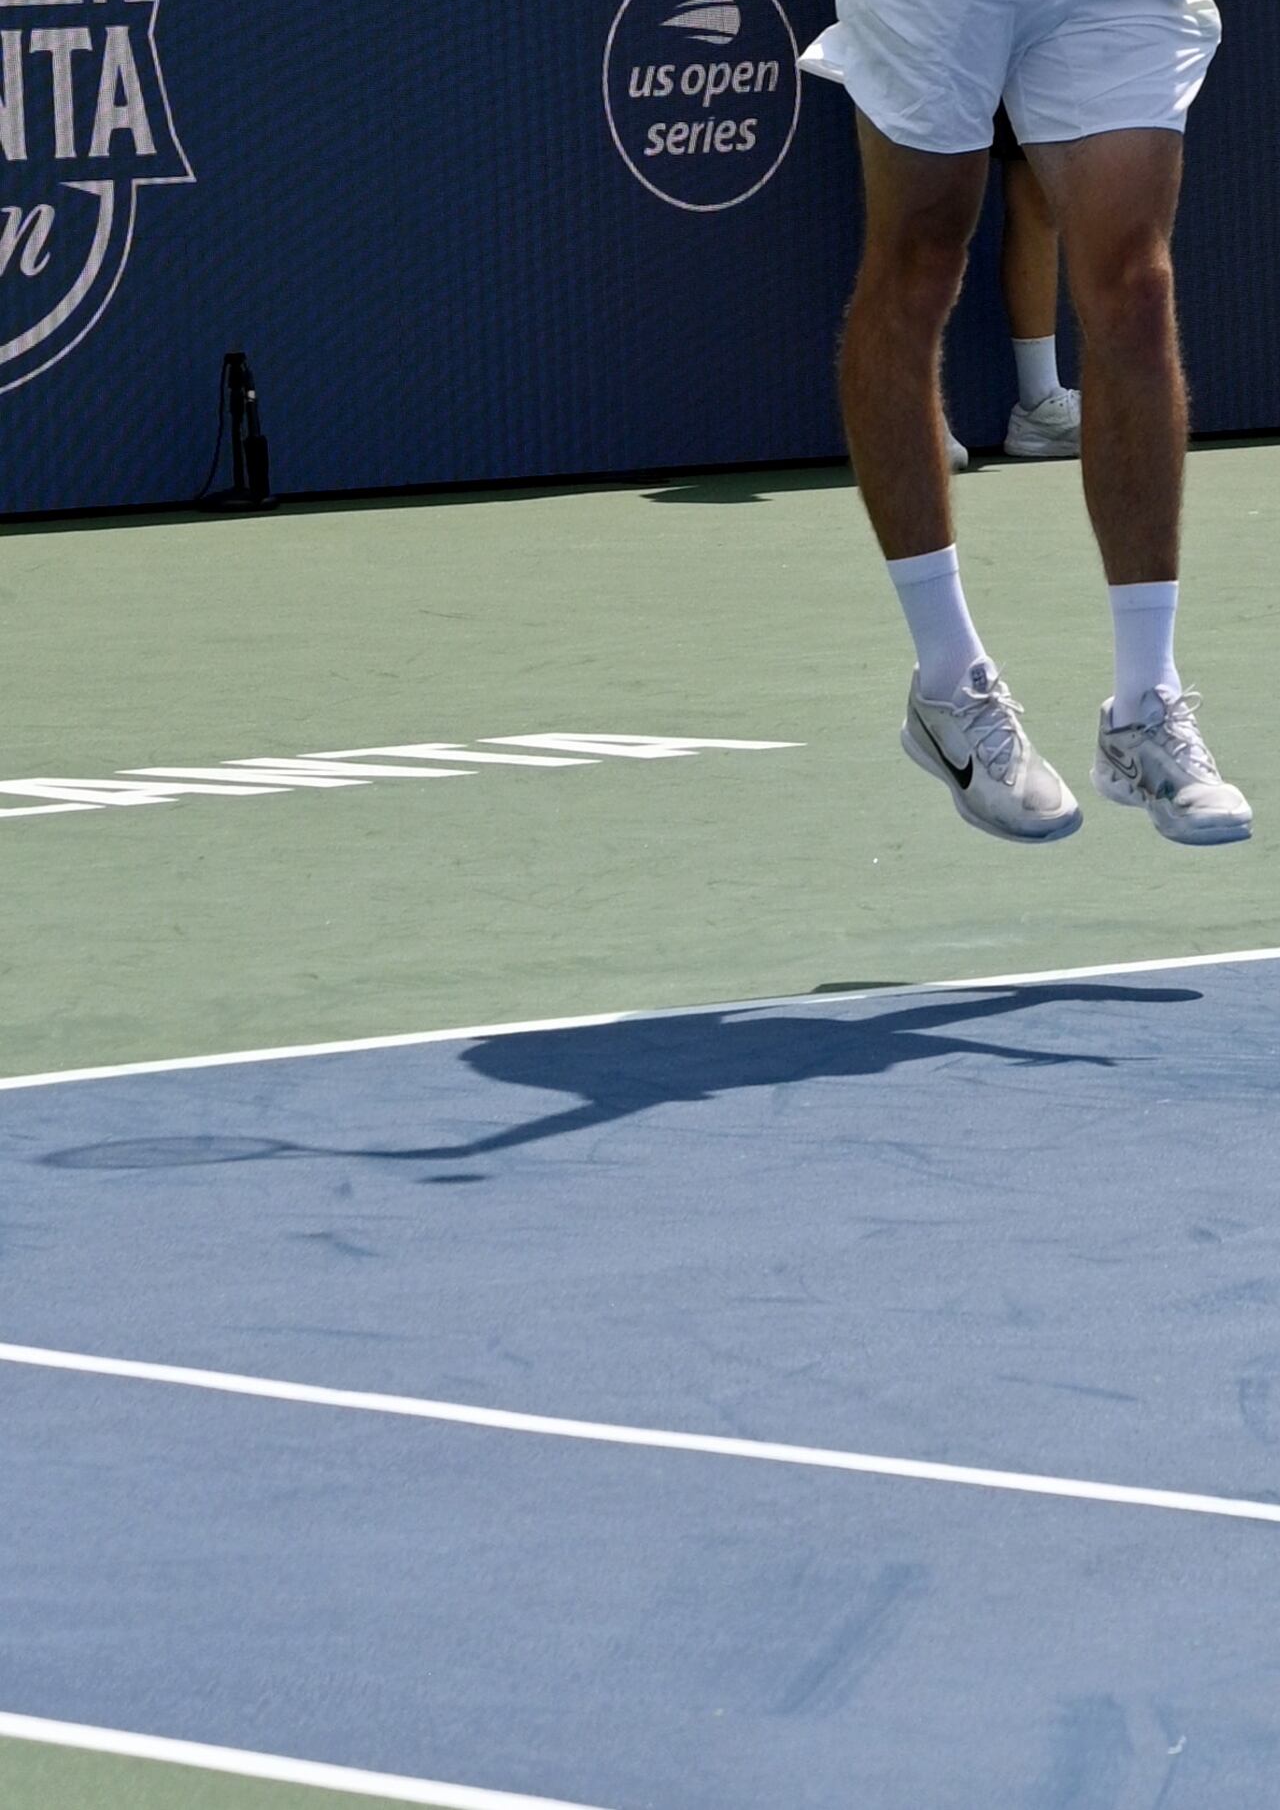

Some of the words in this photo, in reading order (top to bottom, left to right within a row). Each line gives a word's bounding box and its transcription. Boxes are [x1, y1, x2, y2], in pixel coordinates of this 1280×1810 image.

[628, 64, 676, 98] us
[680, 60, 780, 108] open
[643, 116, 759, 156] series
